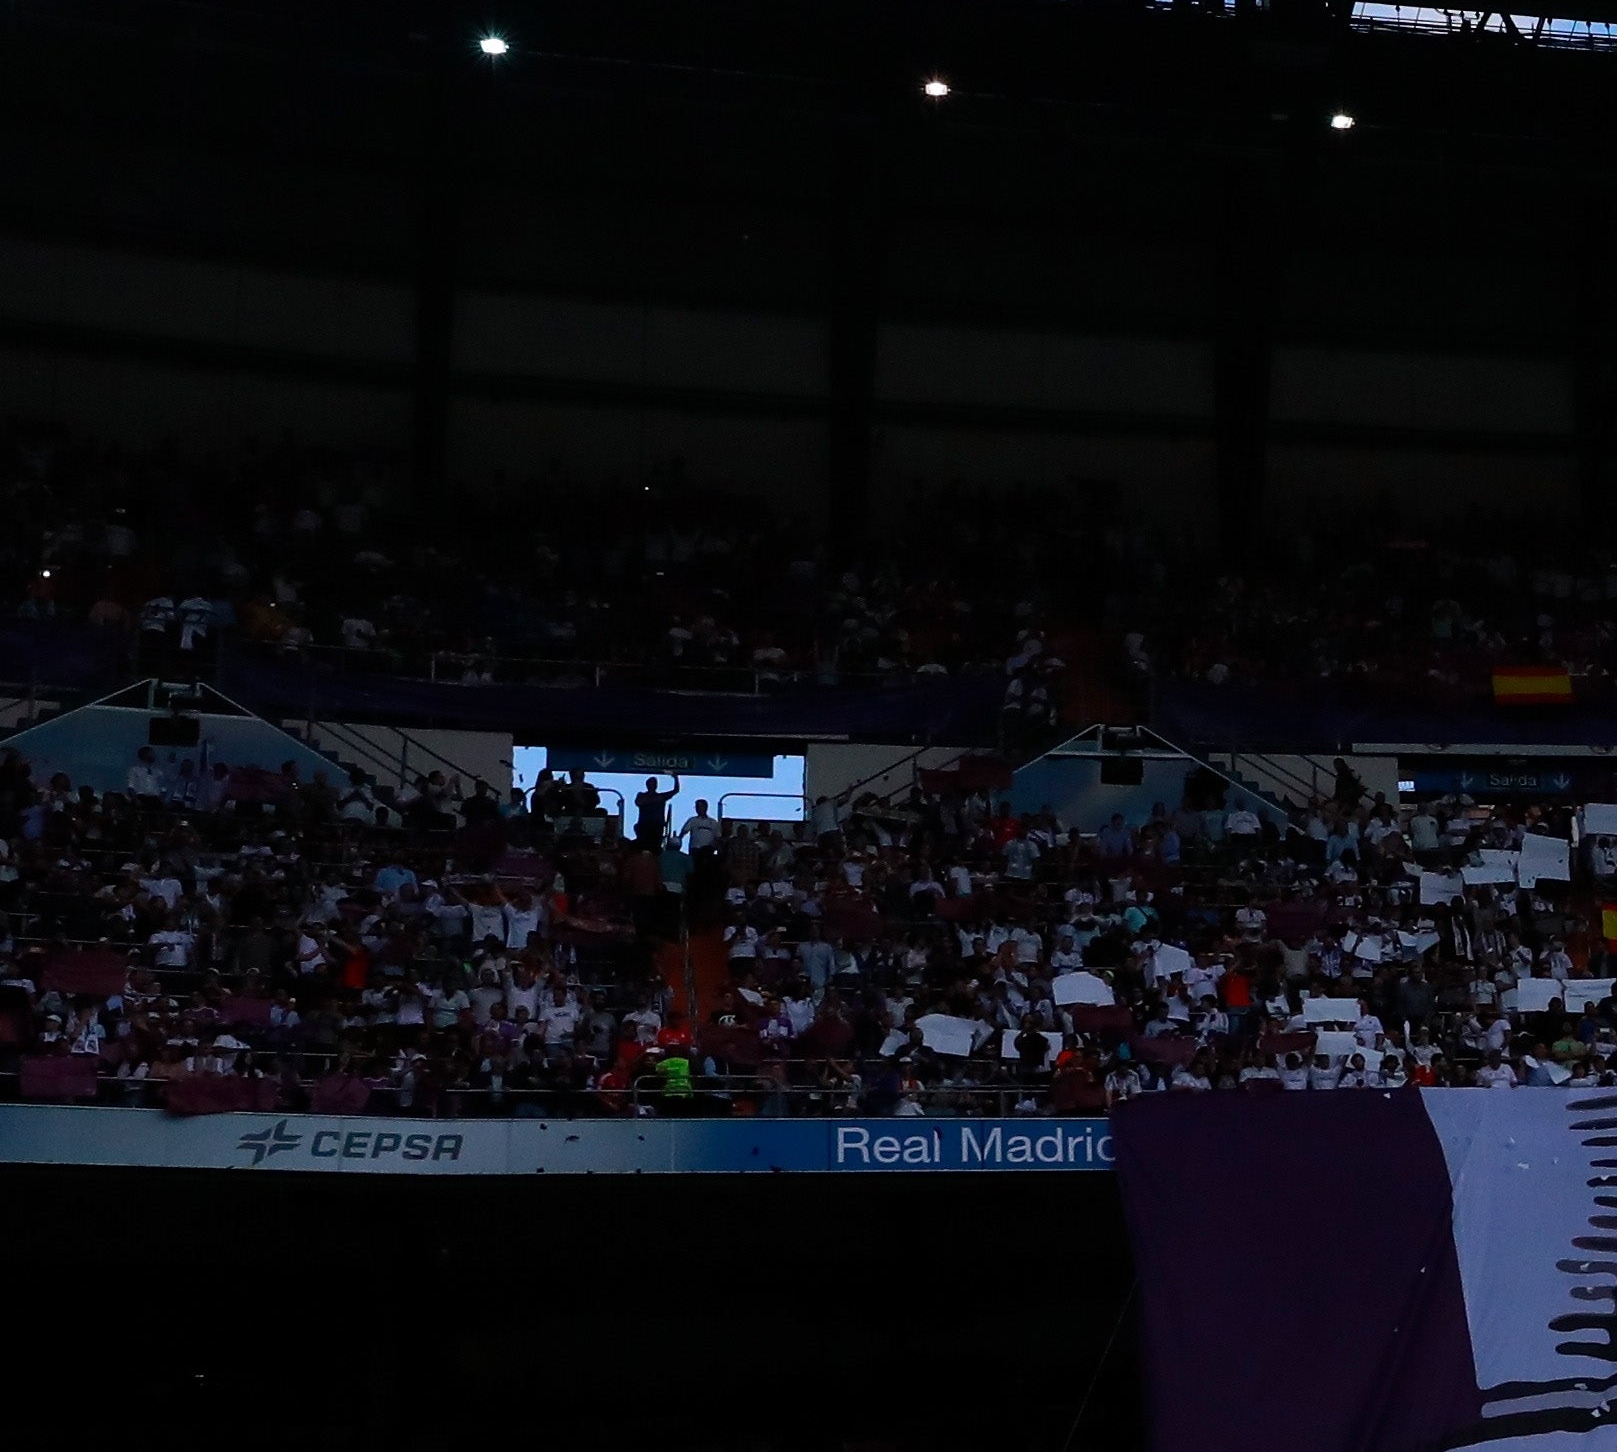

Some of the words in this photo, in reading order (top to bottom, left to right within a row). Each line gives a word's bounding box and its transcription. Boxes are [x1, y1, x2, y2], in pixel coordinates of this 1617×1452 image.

[632, 752, 690, 768] Salida
[310, 1130, 464, 1161] CEPSA
[837, 1127, 942, 1163] Real
